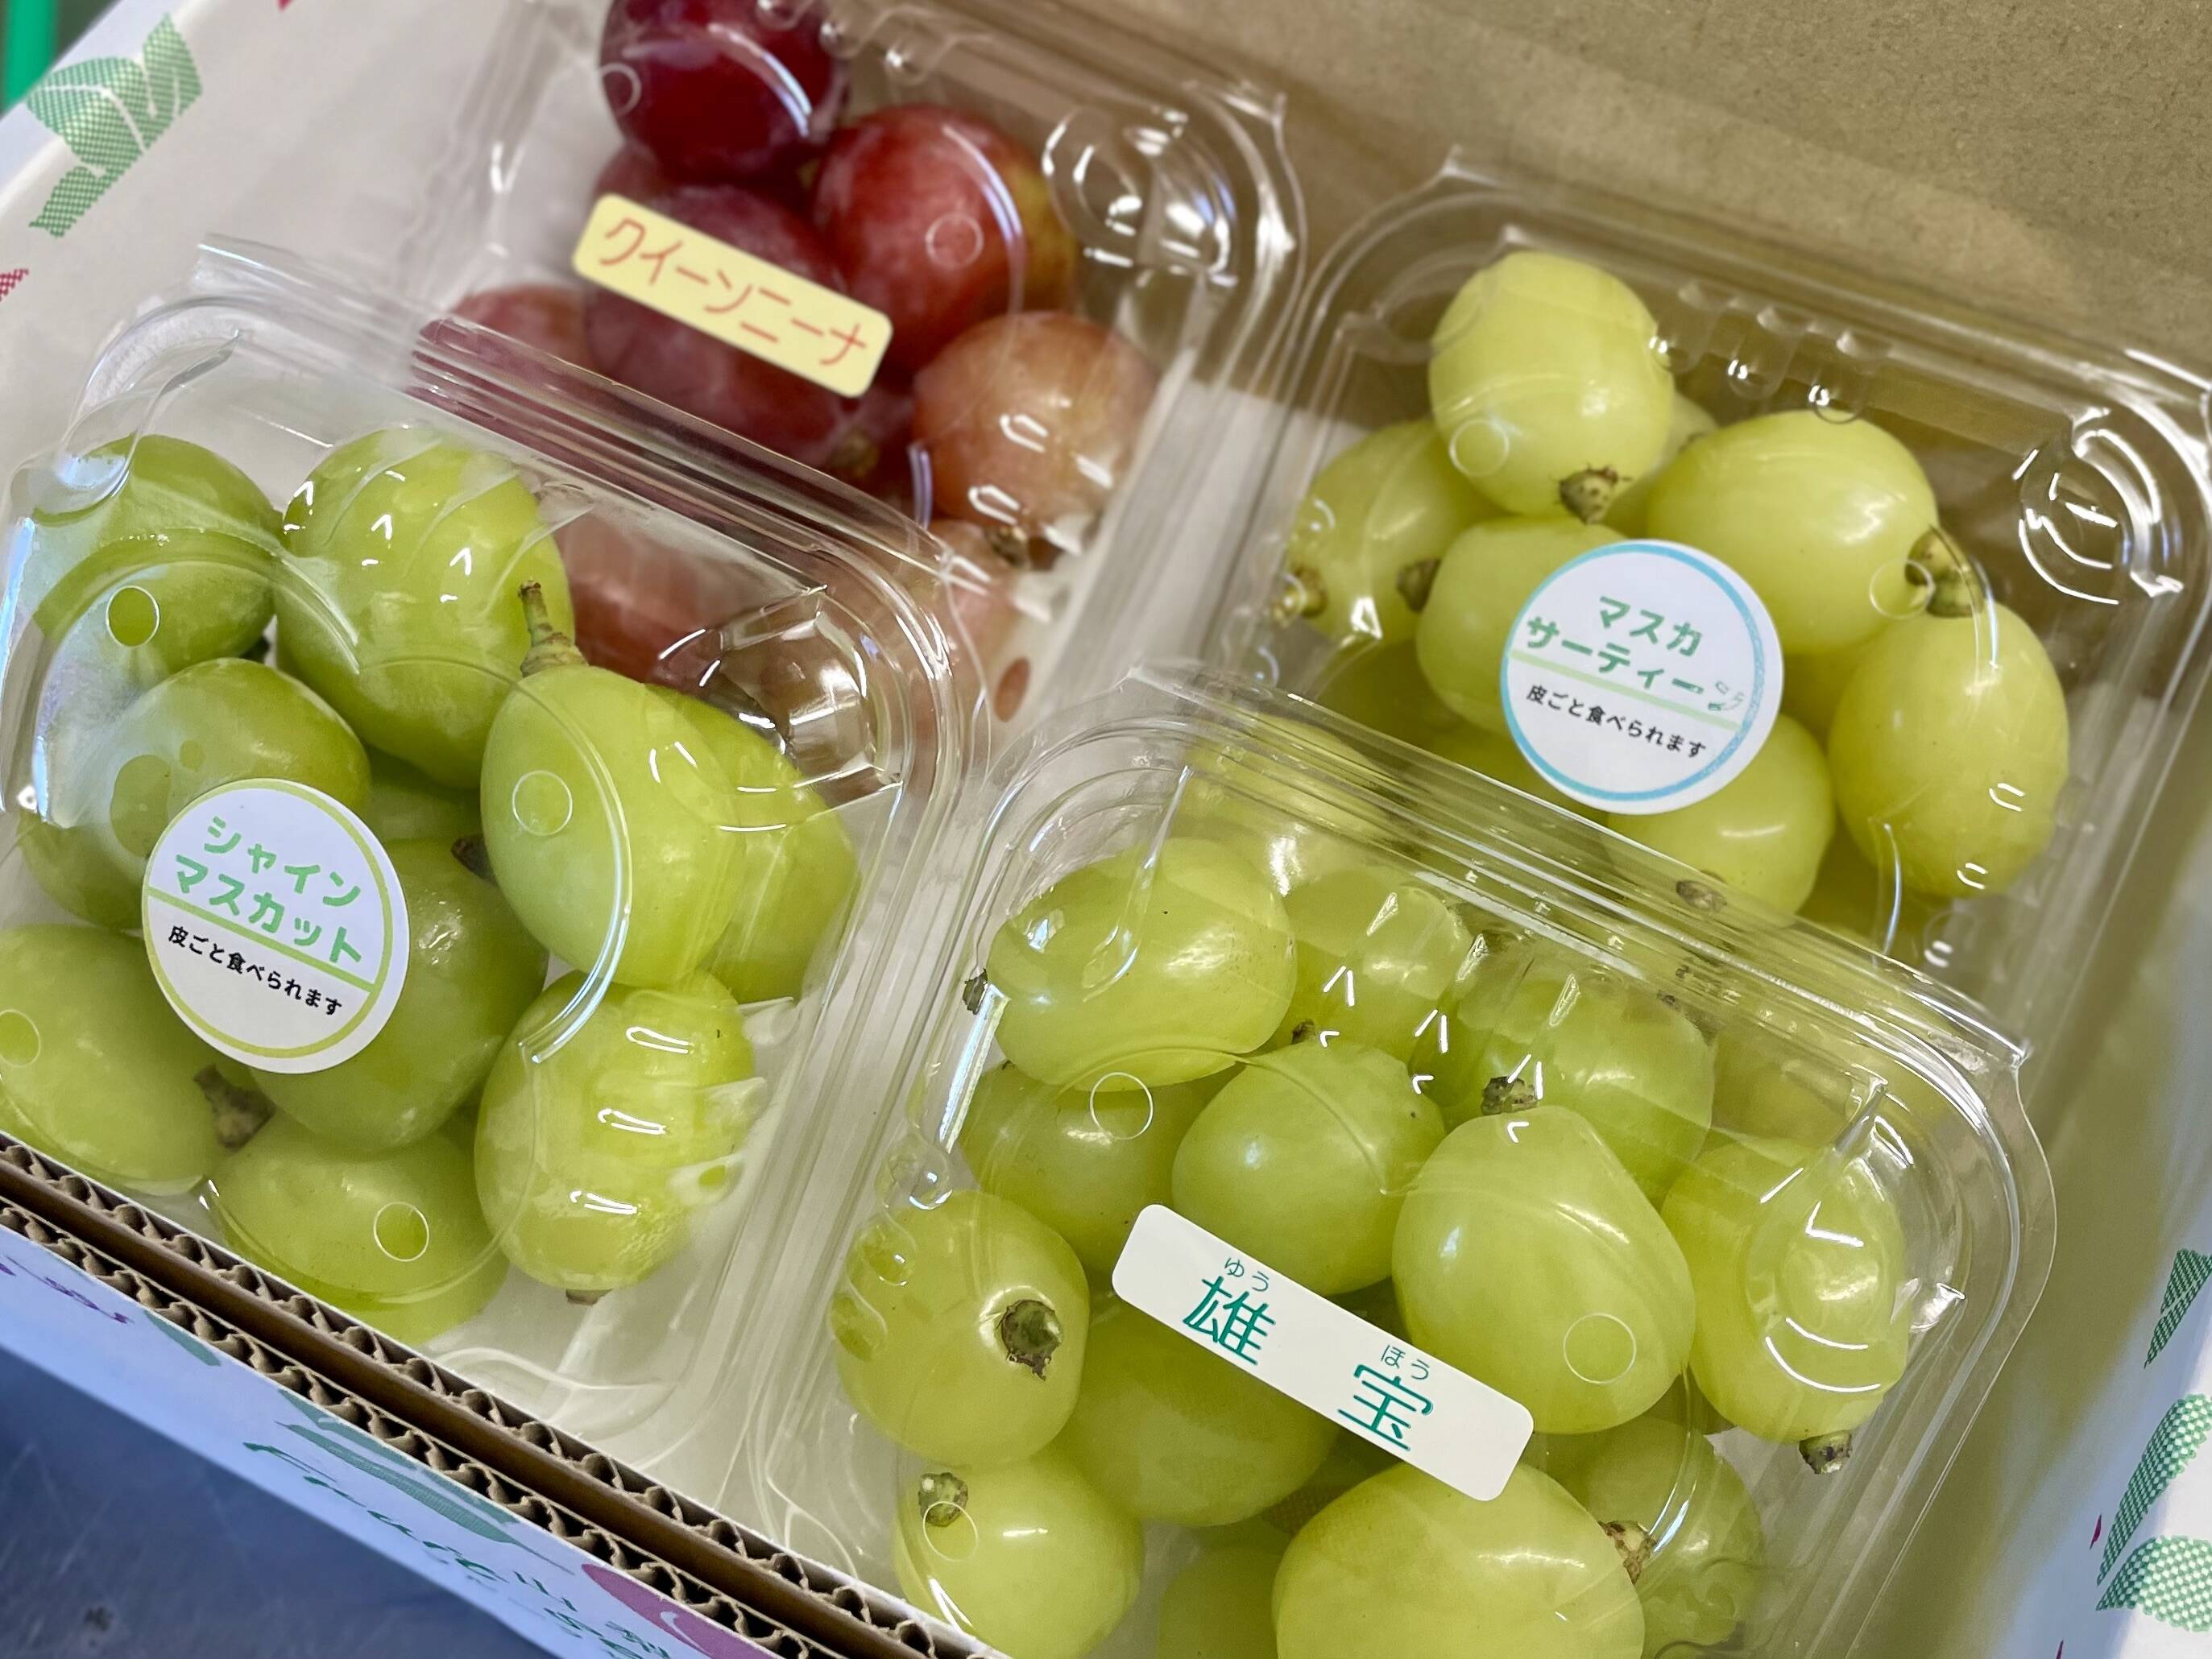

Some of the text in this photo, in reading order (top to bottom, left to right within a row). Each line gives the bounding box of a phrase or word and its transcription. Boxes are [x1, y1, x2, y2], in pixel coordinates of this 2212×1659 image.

[599, 217, 868, 366] クイーンニーナ
[1599, 595, 1703, 657] マスカ
[1526, 684, 1707, 759] 皮ごと食べられます
[204, 815, 362, 907] シャイン
[175, 854, 362, 964] マスカット
[168, 925, 342, 1016] 皮ごと食べられます
[1224, 1256, 1431, 1381] ゆう ほう
